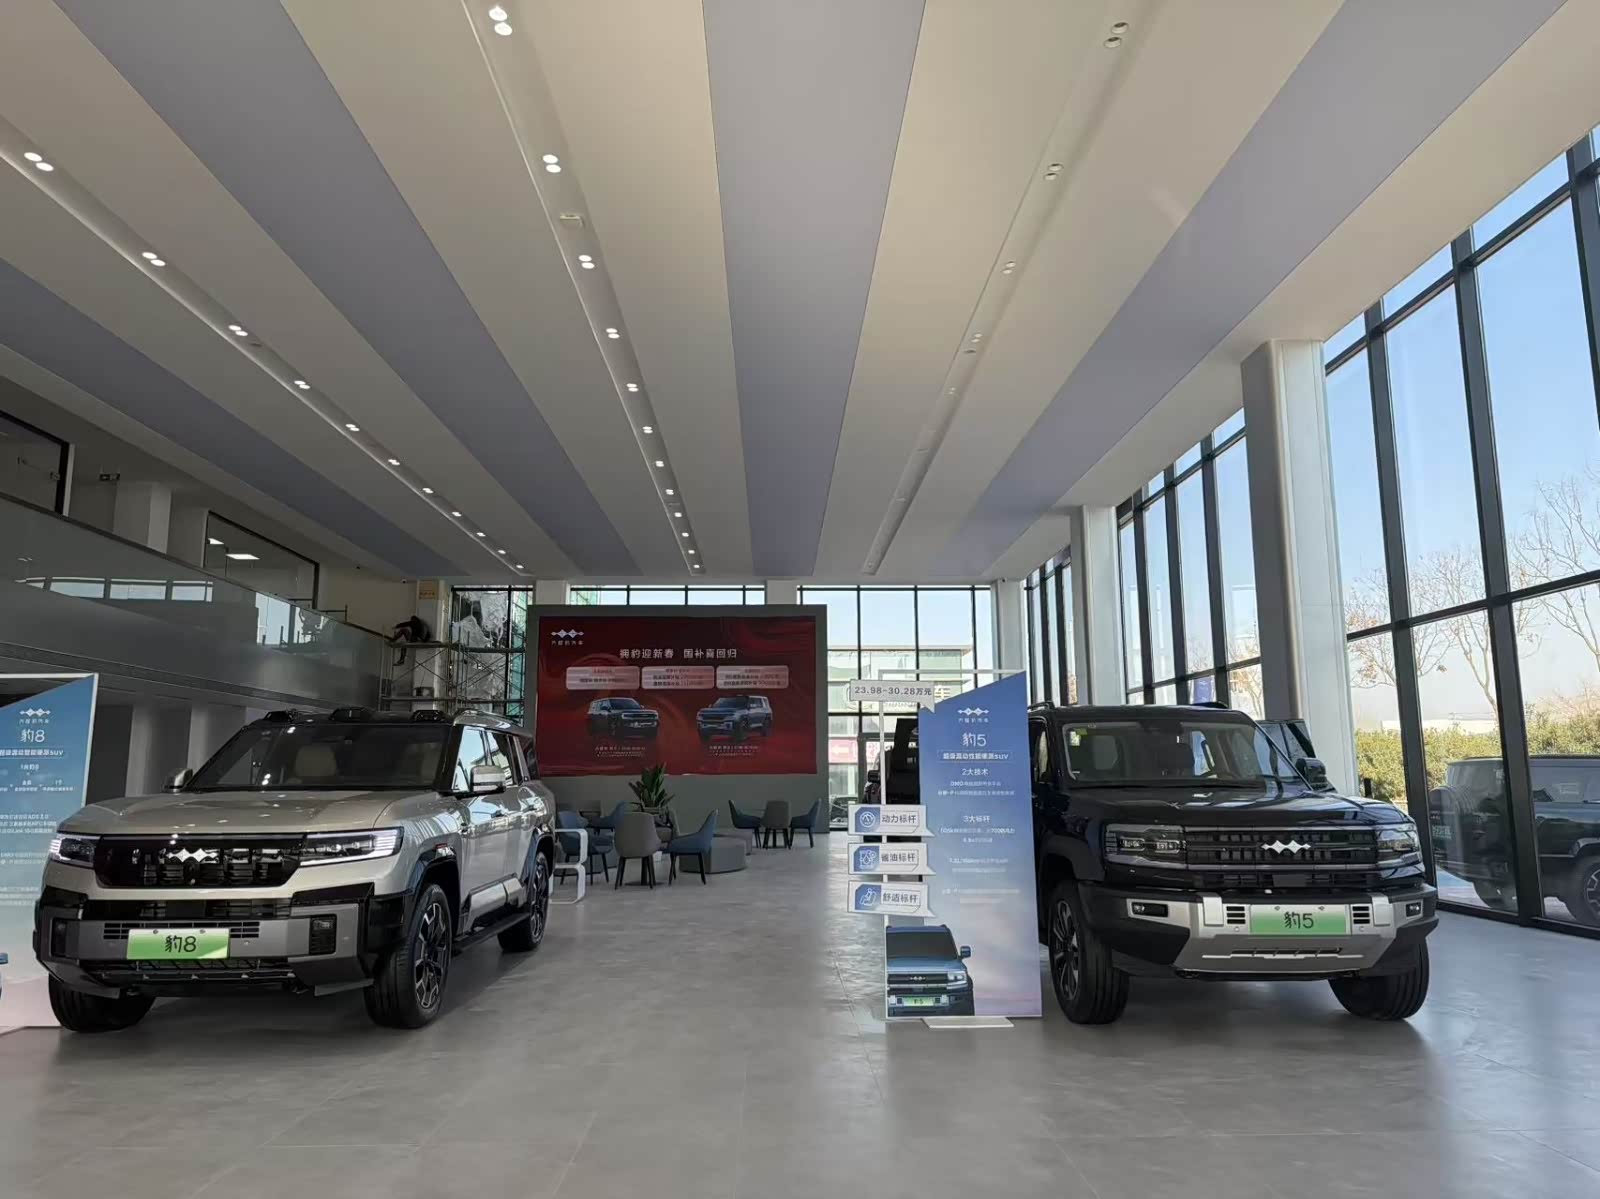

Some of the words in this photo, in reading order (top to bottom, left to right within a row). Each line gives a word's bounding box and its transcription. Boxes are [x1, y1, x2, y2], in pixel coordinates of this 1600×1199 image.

[854, 686, 932, 696] 23.98-30.28万元
[20, 728, 45, 743] 豹8
[962, 732, 987, 747] 豹5
[882, 814, 917, 825] 动力标杆
[881, 852, 916, 863] 省油标杆
[882, 892, 918, 904] 舒适标杆
[1283, 911, 1315, 931] 豹5
[164, 934, 197, 955] 豹8
